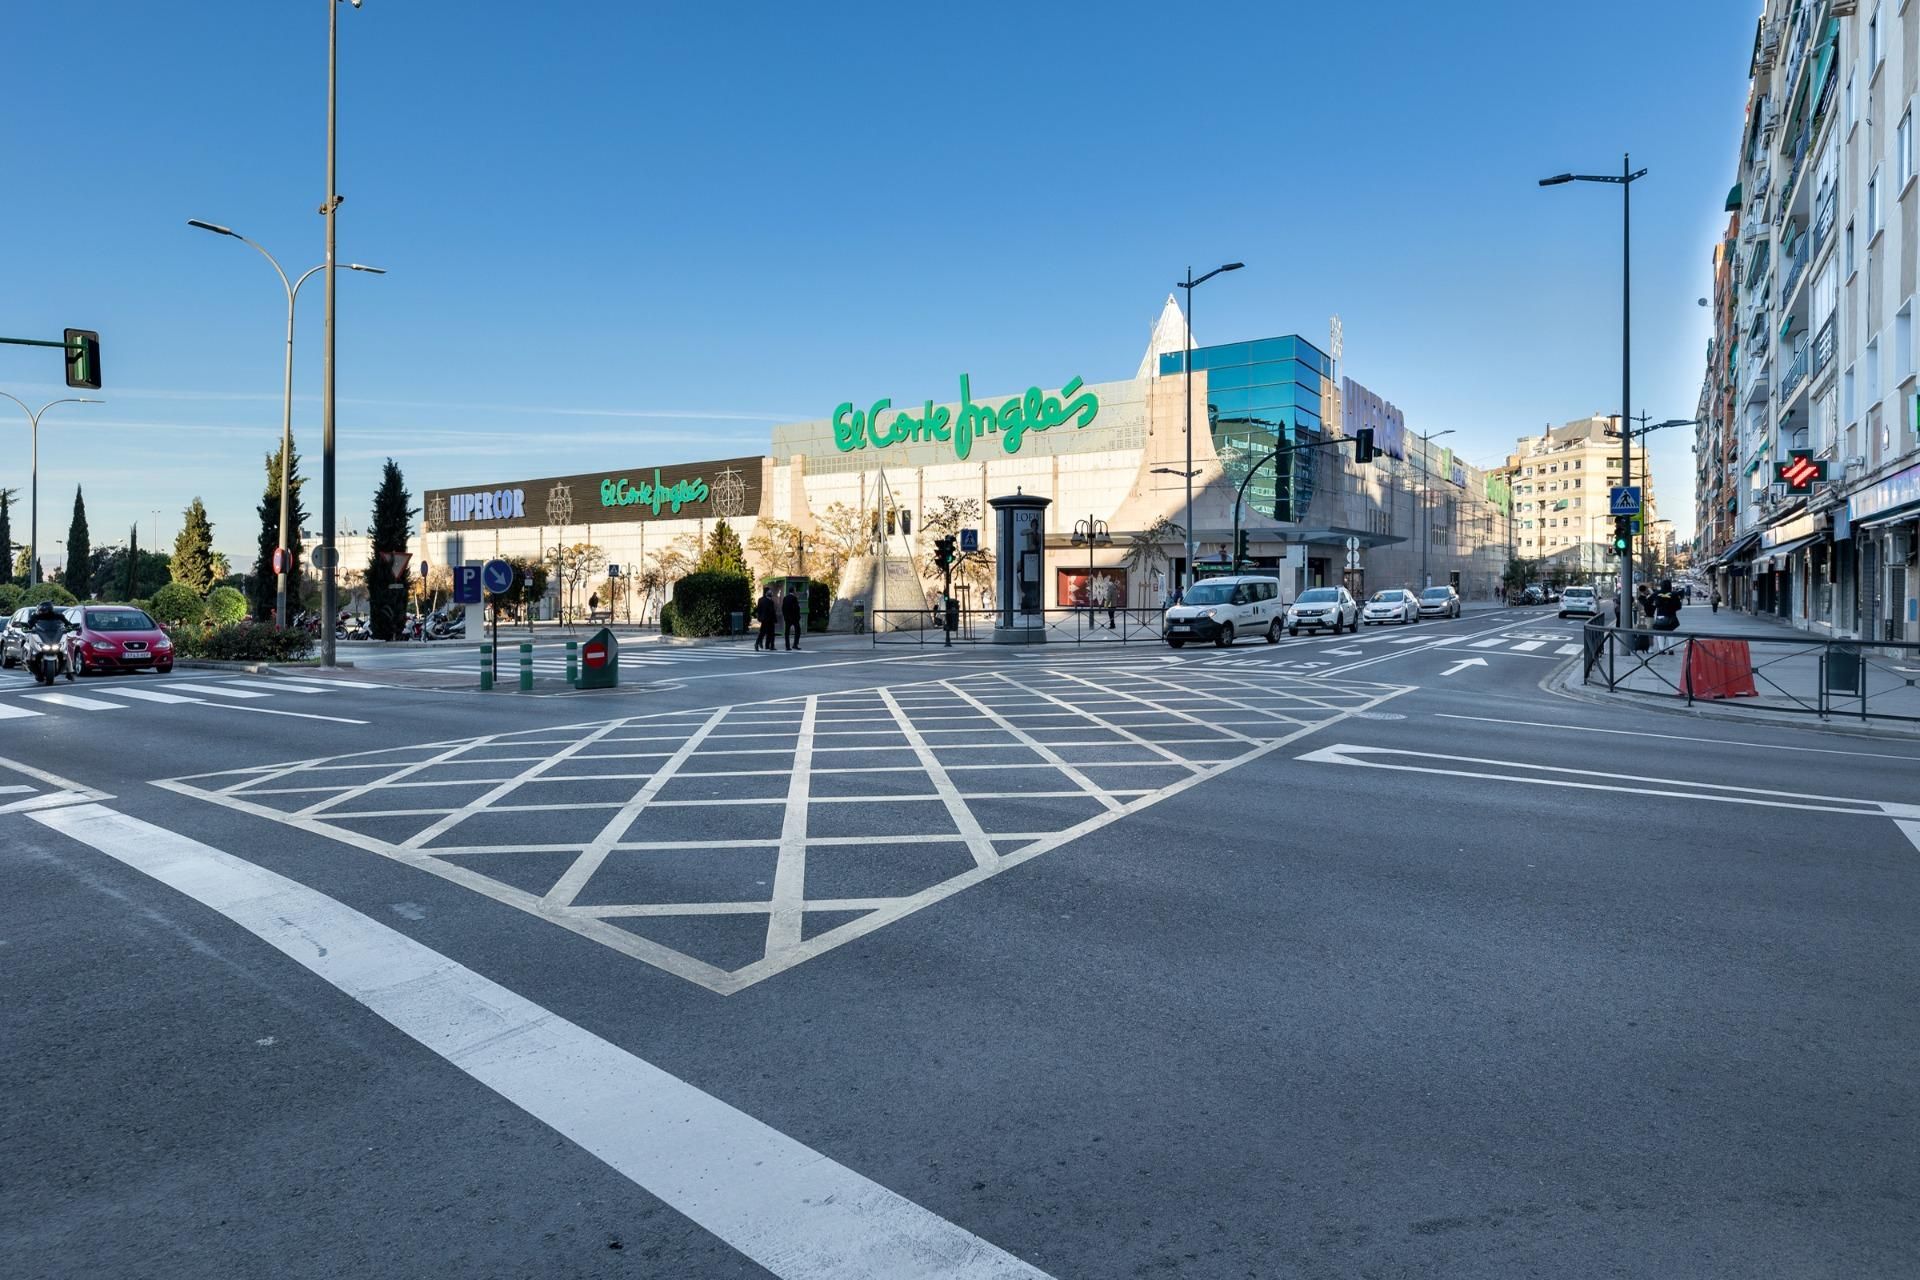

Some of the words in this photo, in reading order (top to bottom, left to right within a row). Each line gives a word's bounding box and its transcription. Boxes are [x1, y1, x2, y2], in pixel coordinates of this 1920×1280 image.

[833, 402, 867, 452] El
[868, 398, 951, 449] Corte
[954, 373, 1100, 461] Inglés
[450, 488, 526, 522] HIPERCOR
[601, 478, 617, 507] El
[617, 478, 653, 506] Corte
[652, 468, 709, 516] Inglés
[463, 568, 476, 585] P
